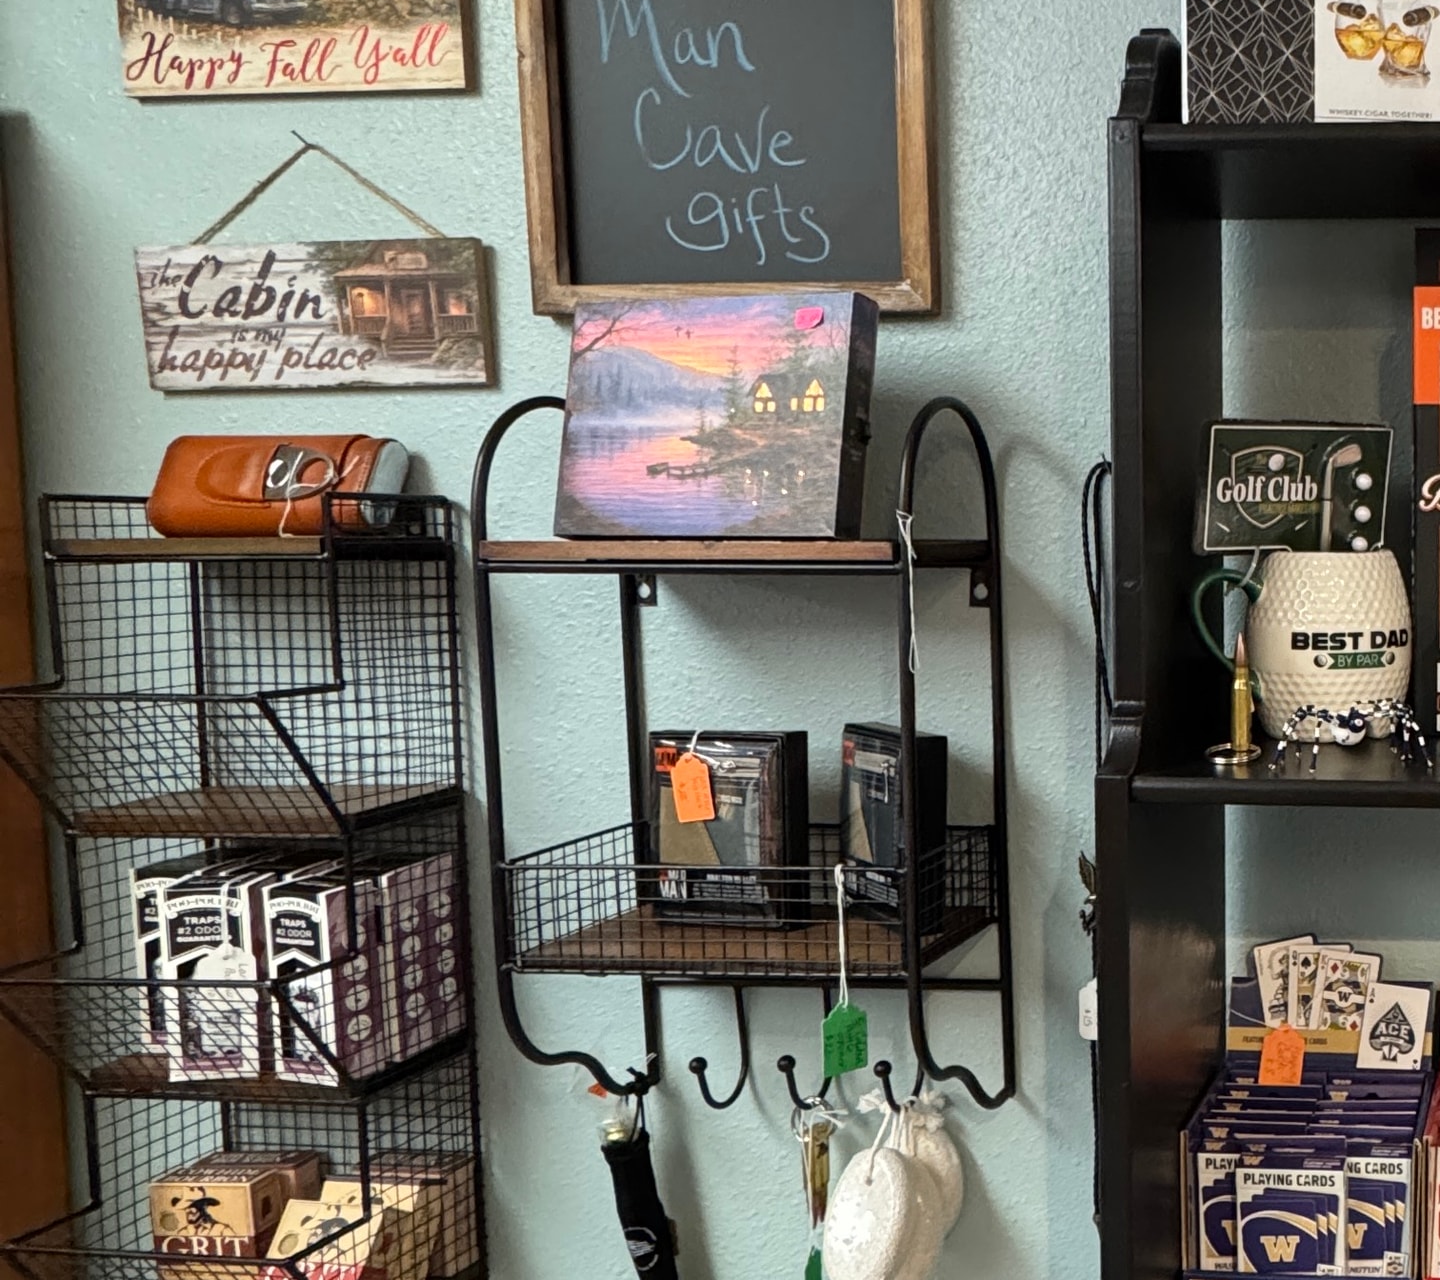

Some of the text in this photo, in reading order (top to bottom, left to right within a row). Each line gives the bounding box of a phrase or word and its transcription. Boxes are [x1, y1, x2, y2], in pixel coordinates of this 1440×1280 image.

[125, 21, 455, 91] Happy Fall Y'all
[634, 87, 807, 174] Cave
[665, 182, 831, 266] gifts
[178, 250, 328, 321] Cabin
[157, 324, 378, 383] happy place
[1216, 474, 1318, 503] Golf Club
[1291, 628, 1409, 650] BEST DAD
[1337, 653, 1379, 667] BY PAR
[184, 916, 222, 925] TRAPS
[280, 918, 307, 928] TRAPS
[177, 926, 191, 935] #2
[287, 929, 312, 938] ODOR
[1376, 1022, 1410, 1039] ACE
[1364, 1162, 1404, 1175] CARDS
[1243, 1173, 1336, 1188] PLAYING CARDS
[1259, 1234, 1300, 1263] W
